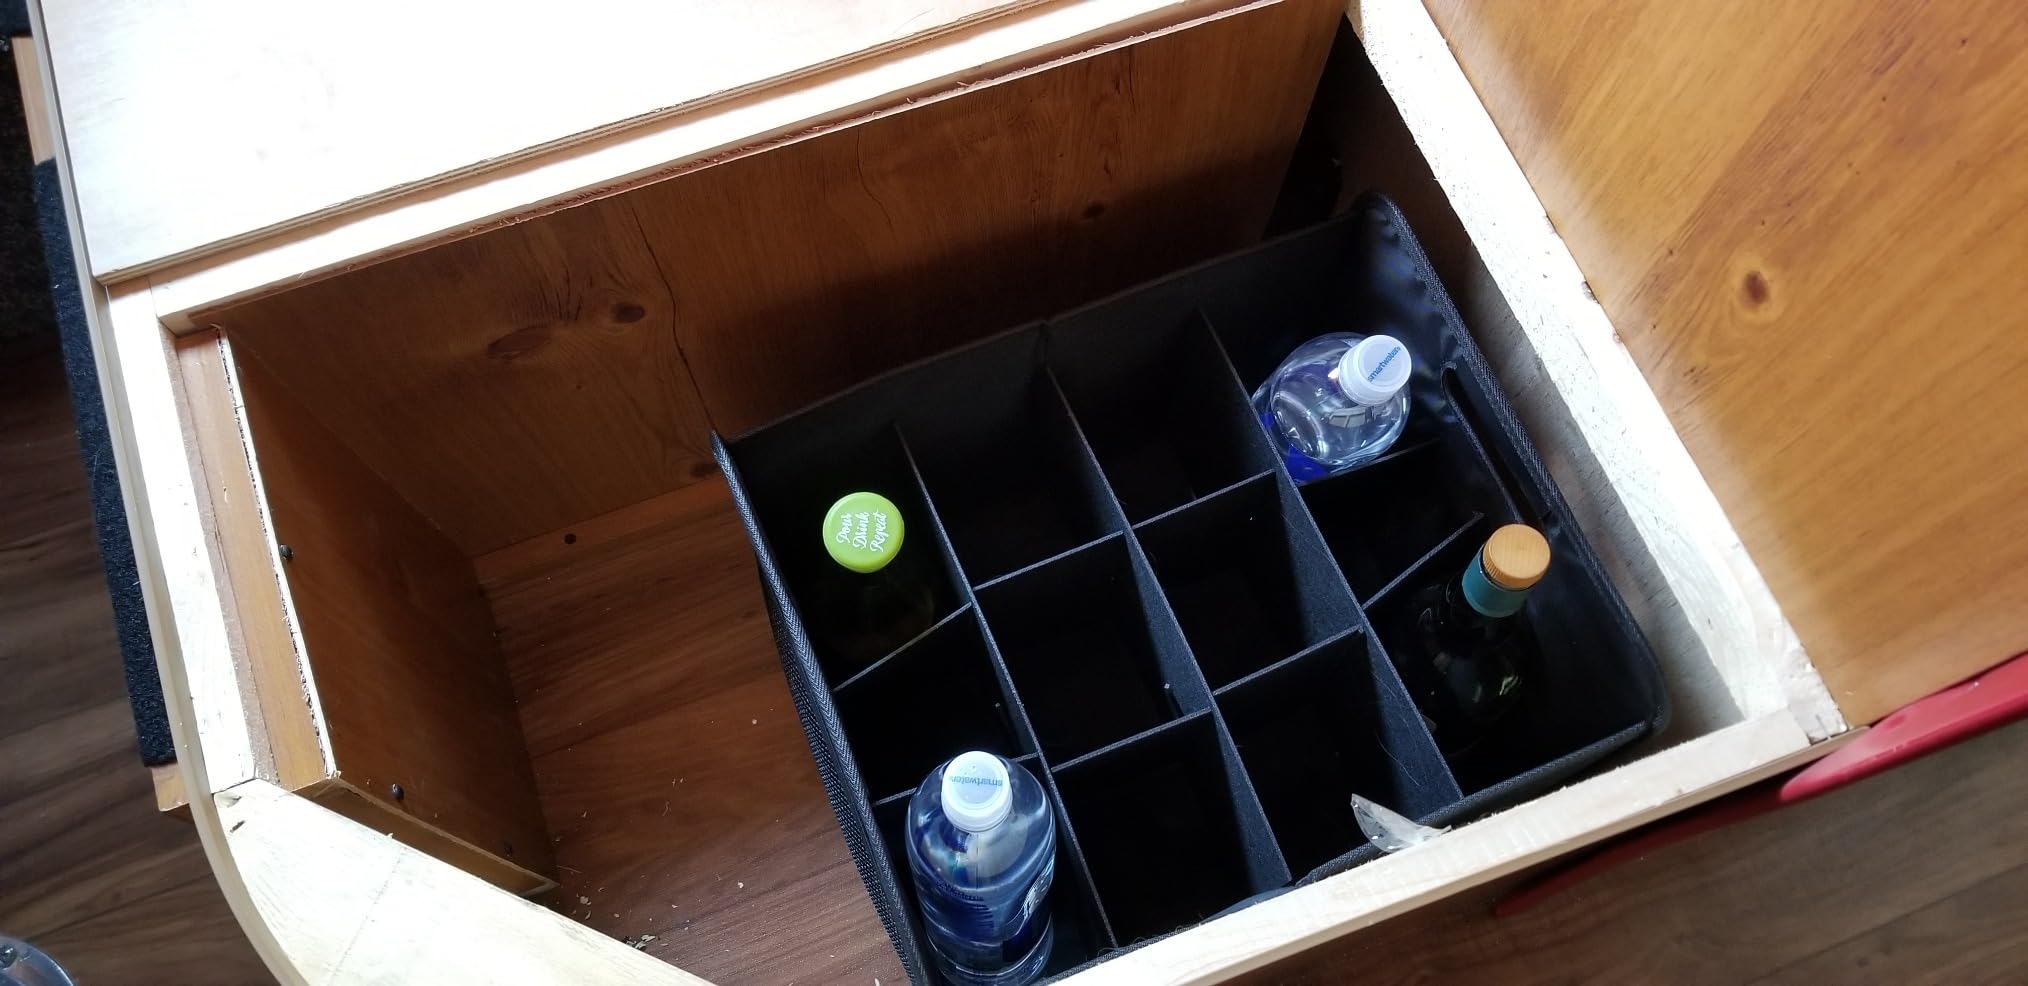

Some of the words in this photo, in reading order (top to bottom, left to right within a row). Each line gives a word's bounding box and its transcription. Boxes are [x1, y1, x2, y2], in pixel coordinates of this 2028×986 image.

[1367, 346, 1401, 383] smartwater
[836, 513, 852, 544] Pour
[852, 511, 870, 550] Drink
[869, 508, 889, 553] Repeat
[950, 775, 1003, 787] smartwater
